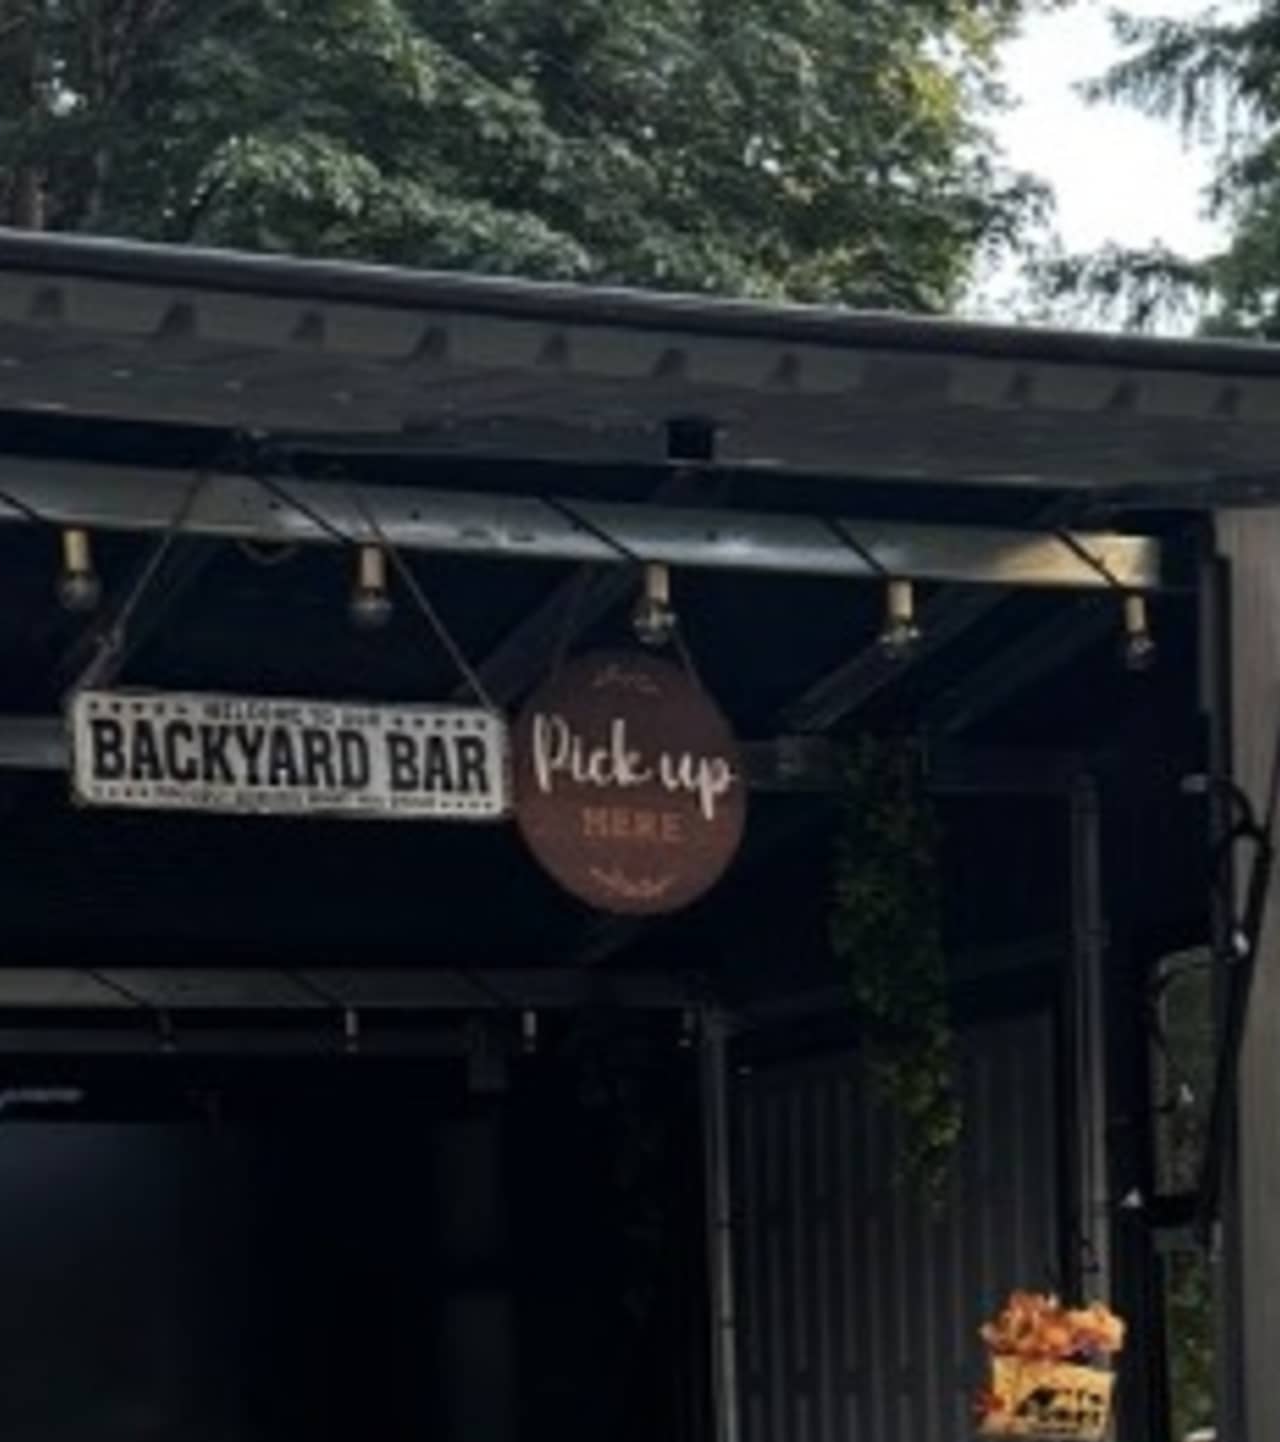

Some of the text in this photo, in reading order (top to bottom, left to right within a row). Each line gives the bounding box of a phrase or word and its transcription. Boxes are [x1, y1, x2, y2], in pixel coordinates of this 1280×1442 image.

[89, 718, 489, 794] BACKYARD BAR
[533, 712, 739, 821] Pick up
[582, 807, 682, 842] HERE
